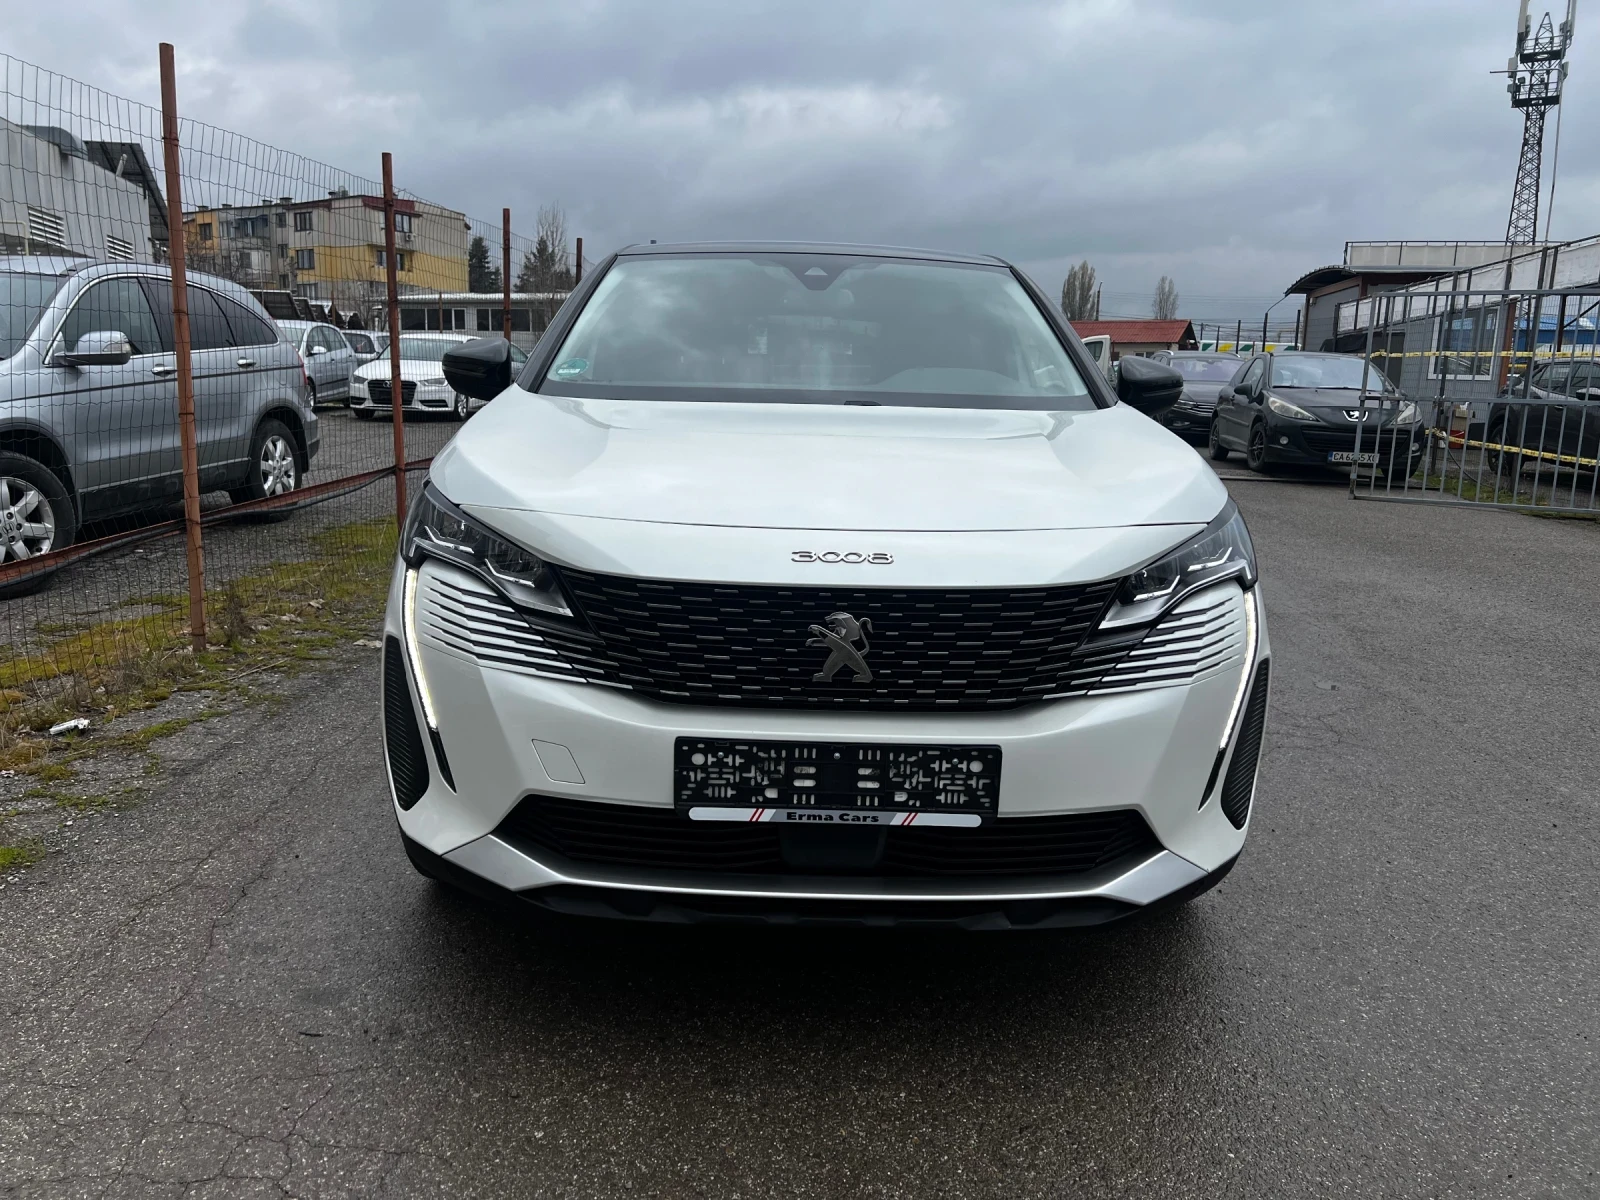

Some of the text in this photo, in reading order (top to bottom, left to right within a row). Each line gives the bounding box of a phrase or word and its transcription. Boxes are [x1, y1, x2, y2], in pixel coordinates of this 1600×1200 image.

[791, 551, 894, 564] 3008
[786, 811, 879, 823] Erma Cars
